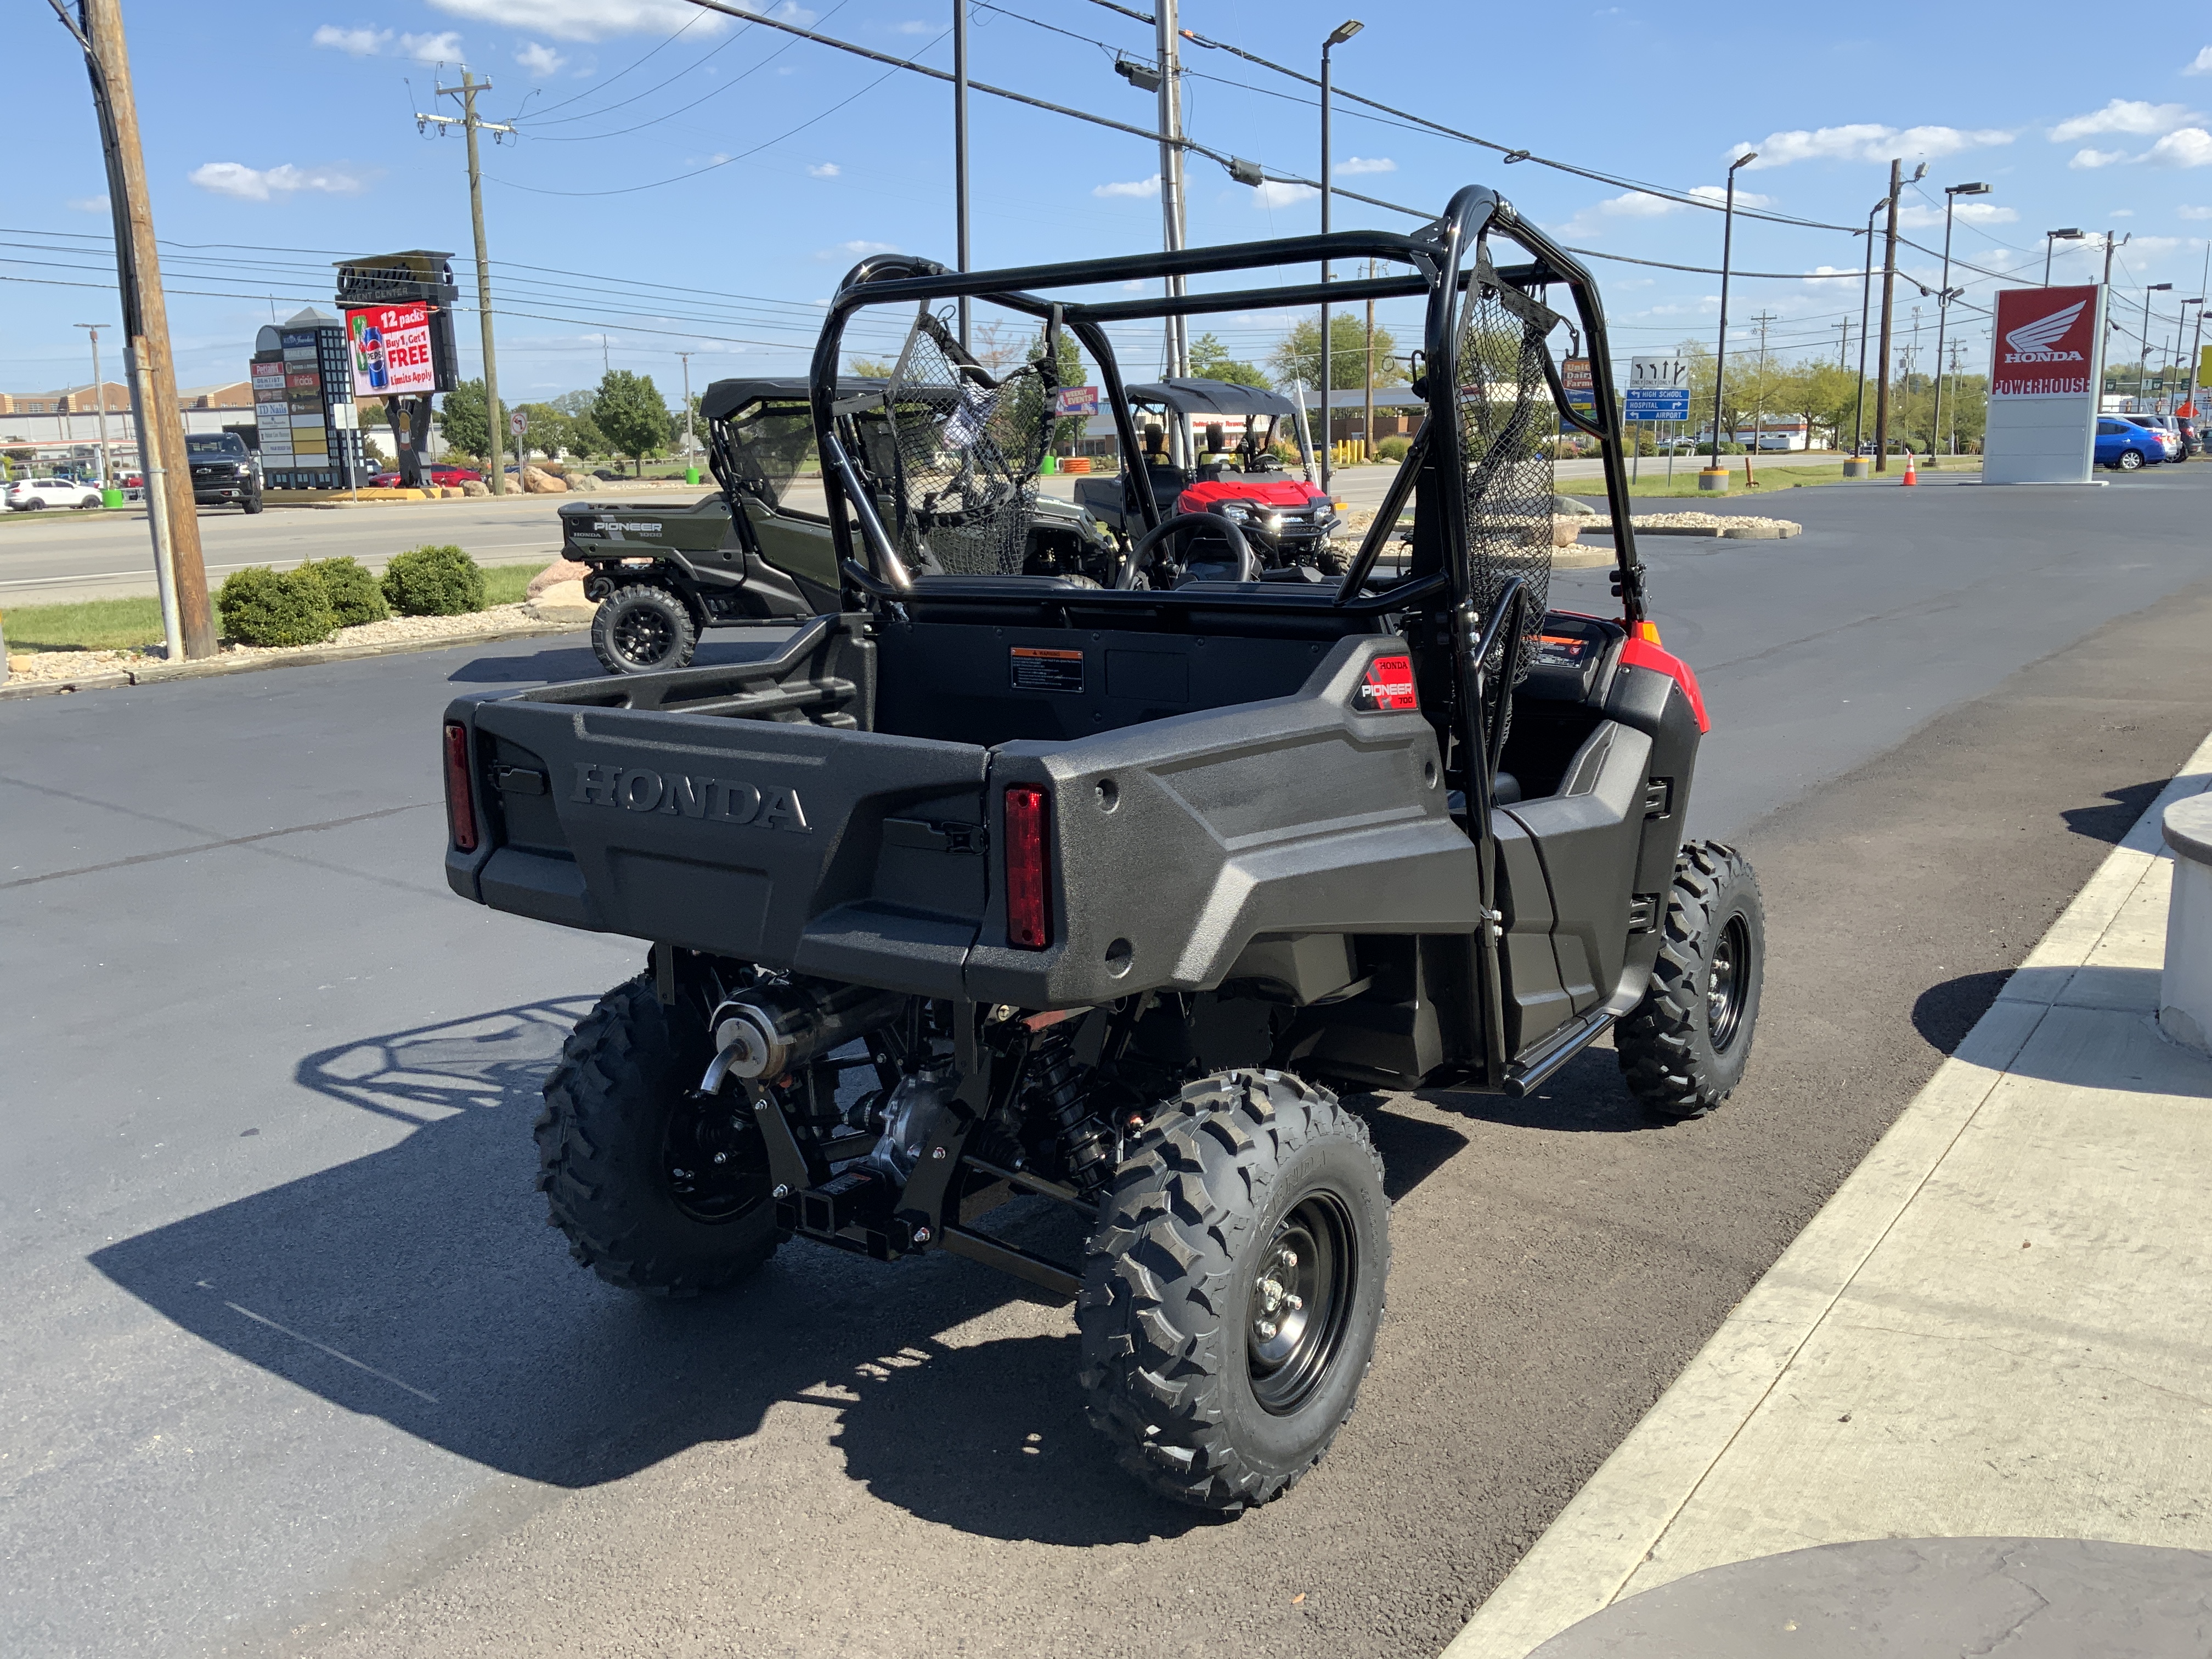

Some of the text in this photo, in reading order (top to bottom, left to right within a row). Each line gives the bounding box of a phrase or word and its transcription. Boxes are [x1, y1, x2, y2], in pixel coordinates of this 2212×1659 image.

[346, 287, 409, 301] EVENT CENTER
[380, 308, 425, 328] 12 packs
[386, 338, 400, 348] Buy
[408, 334, 421, 344] Get
[421, 330, 426, 341] 1
[387, 343, 429, 369] FREE
[2004, 351, 2084, 363] HONDA
[256, 364, 278, 374] Petland
[1566, 363, 1590, 371] Unit
[390, 369, 432, 386] Limits Apply
[1992, 377, 2091, 395] POWERHOUSE
[1065, 388, 1087, 398] WEEKLY
[1068, 394, 1093, 405] EVENTS!
[258, 405, 269, 414] TD
[270, 403, 287, 414] Nails
[594, 522, 662, 532] PIONEER
[1379, 661, 1408, 669] HONDA
[1362, 682, 1412, 697] PIONEER
[1398, 696, 1413, 704] 700
[569, 761, 812, 834] HONDA
